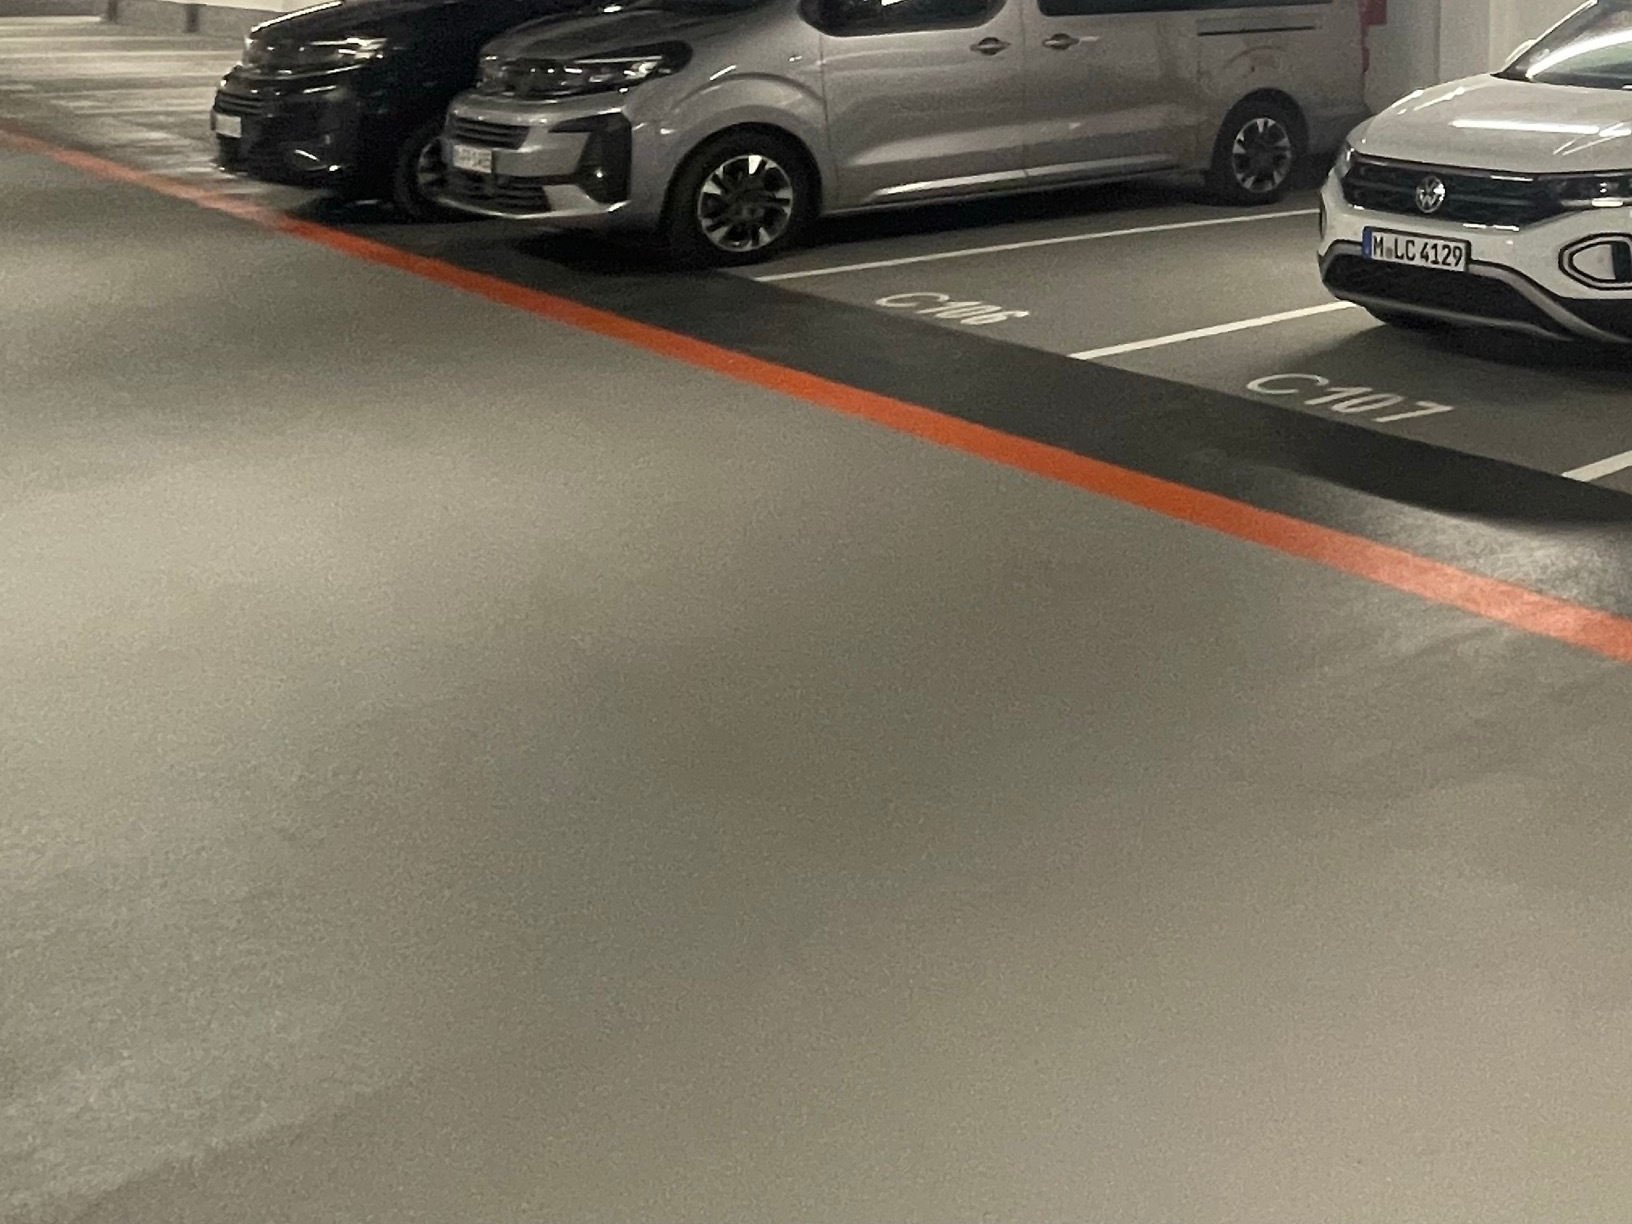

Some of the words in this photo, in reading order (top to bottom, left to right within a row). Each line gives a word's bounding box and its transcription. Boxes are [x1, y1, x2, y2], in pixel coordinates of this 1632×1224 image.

[1373, 235, 1384, 258] M
[1394, 238, 1415, 261] LC
[1420, 242, 1463, 267] 4129
[875, 292, 950, 308] C
[915, 301, 1030, 326] 106
[1247, 373, 1329, 394] C
[1304, 387, 1454, 422] 107
